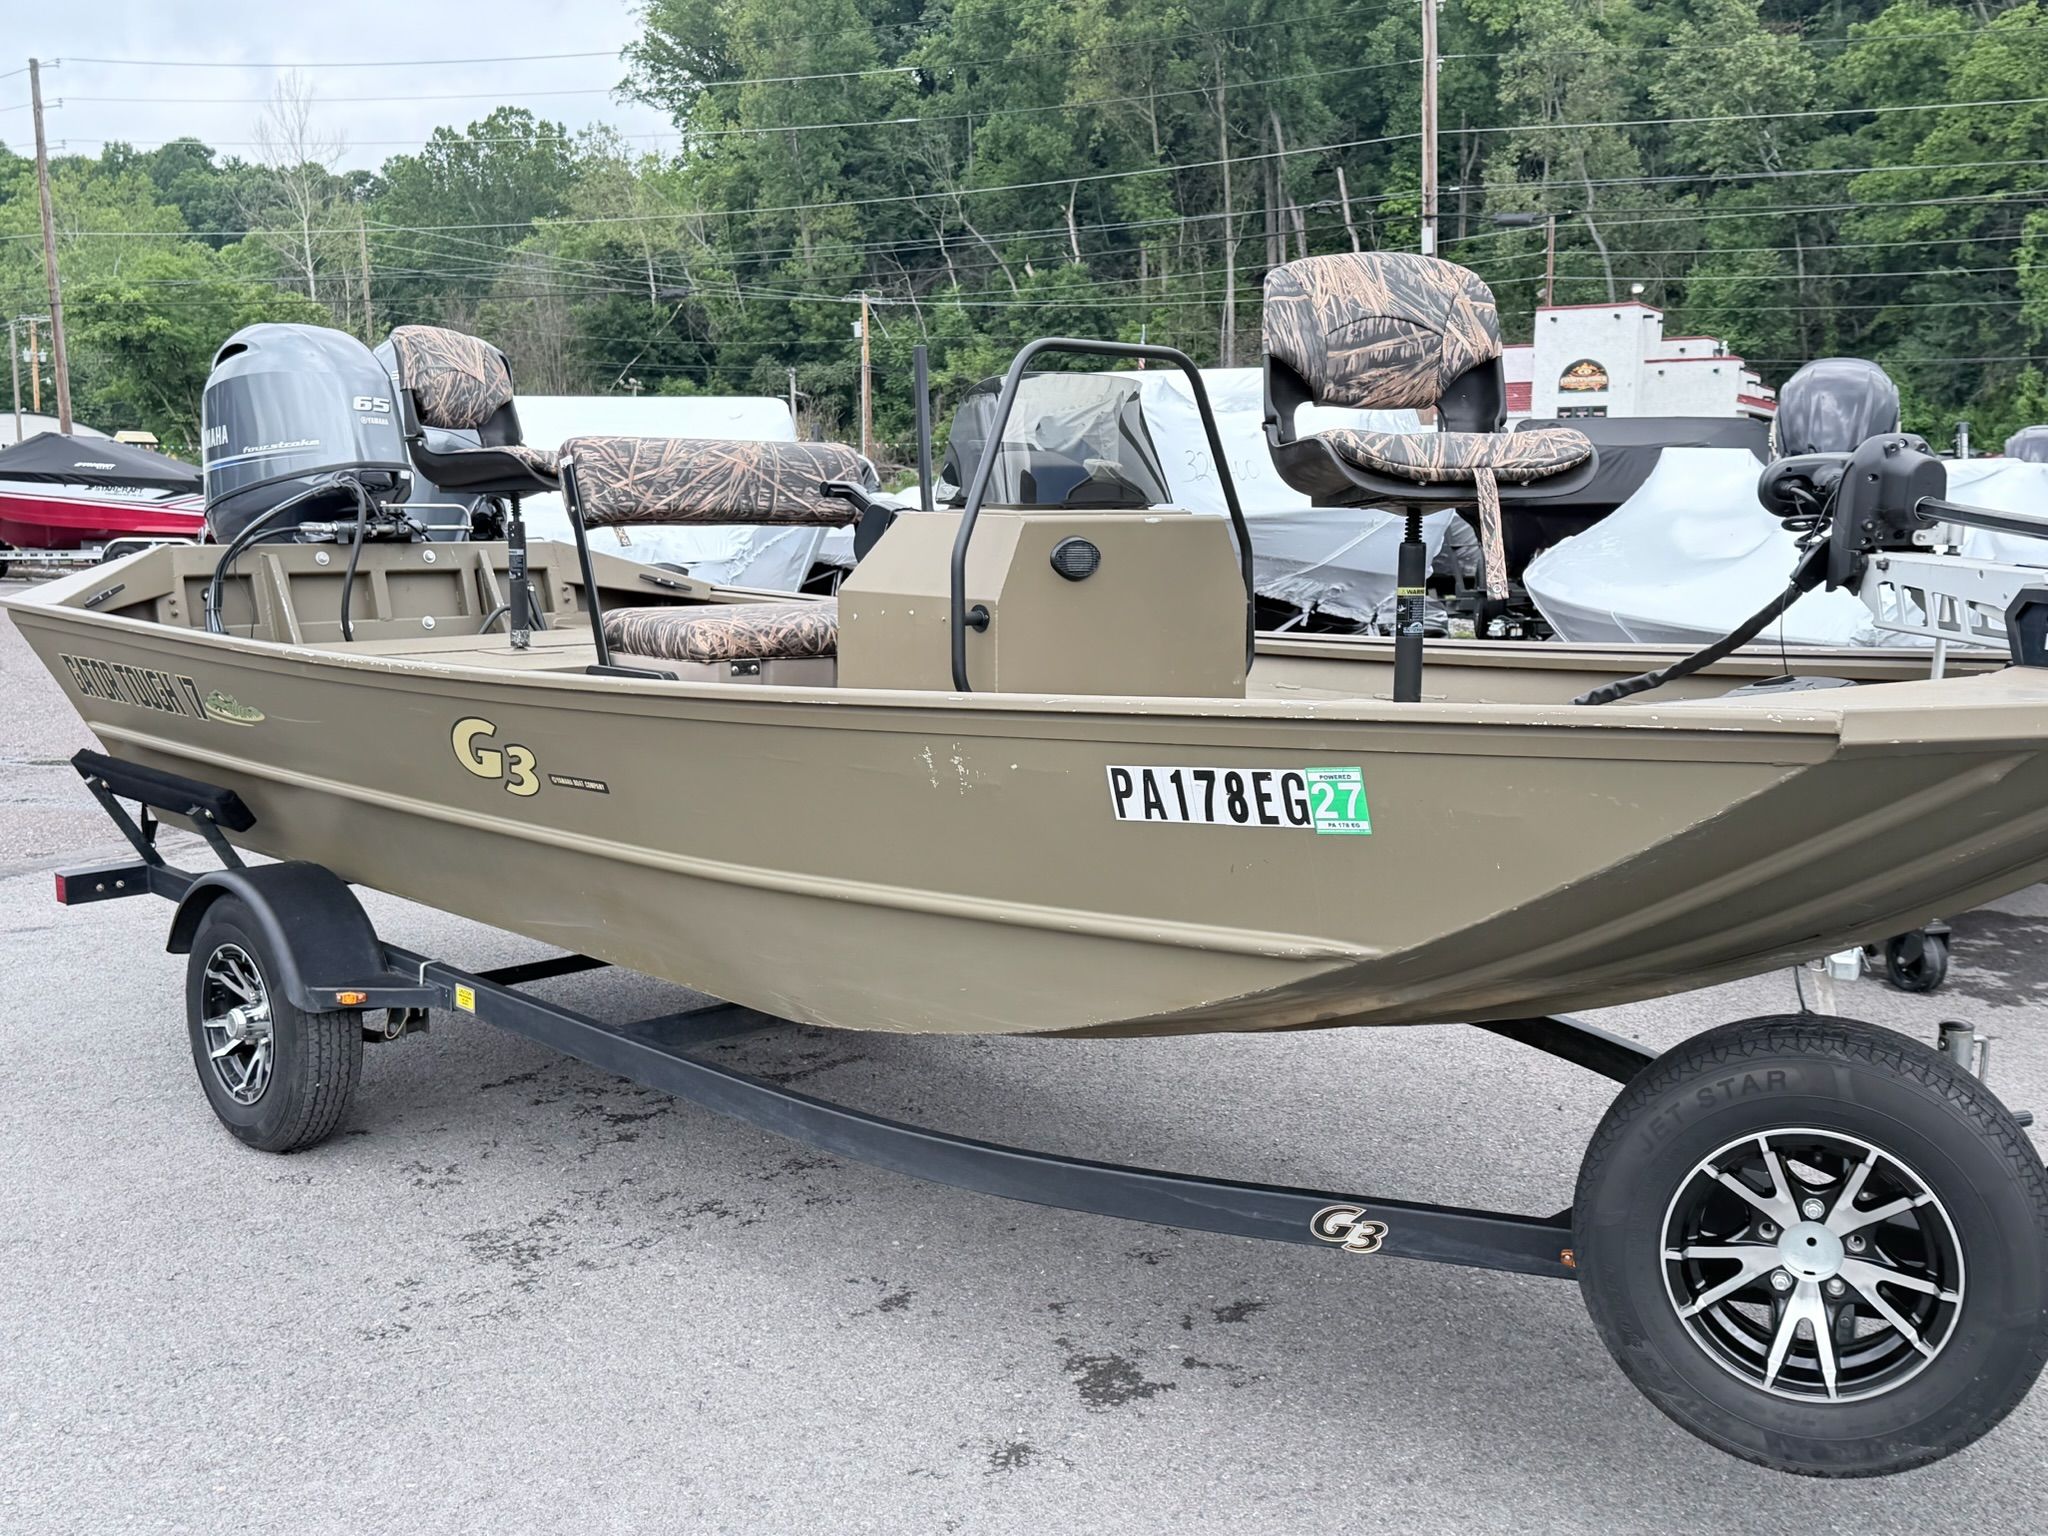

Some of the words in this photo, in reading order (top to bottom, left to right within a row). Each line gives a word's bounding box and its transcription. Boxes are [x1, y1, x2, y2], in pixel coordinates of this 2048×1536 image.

[353, 396, 390, 412] 65
[202, 424, 229, 449] MAHA
[59, 654, 129, 704] GATOR
[111, 662, 189, 716] TOUGH
[175, 674, 210, 721] 17
[451, 716, 540, 797] G3
[1110, 767, 1311, 826] PA178EG
[1311, 782, 1362, 819] 27
[1640, 1102, 1684, 1154] JET
[1696, 1070, 1787, 1108] STAR
[1310, 1205, 1389, 1254] G3
